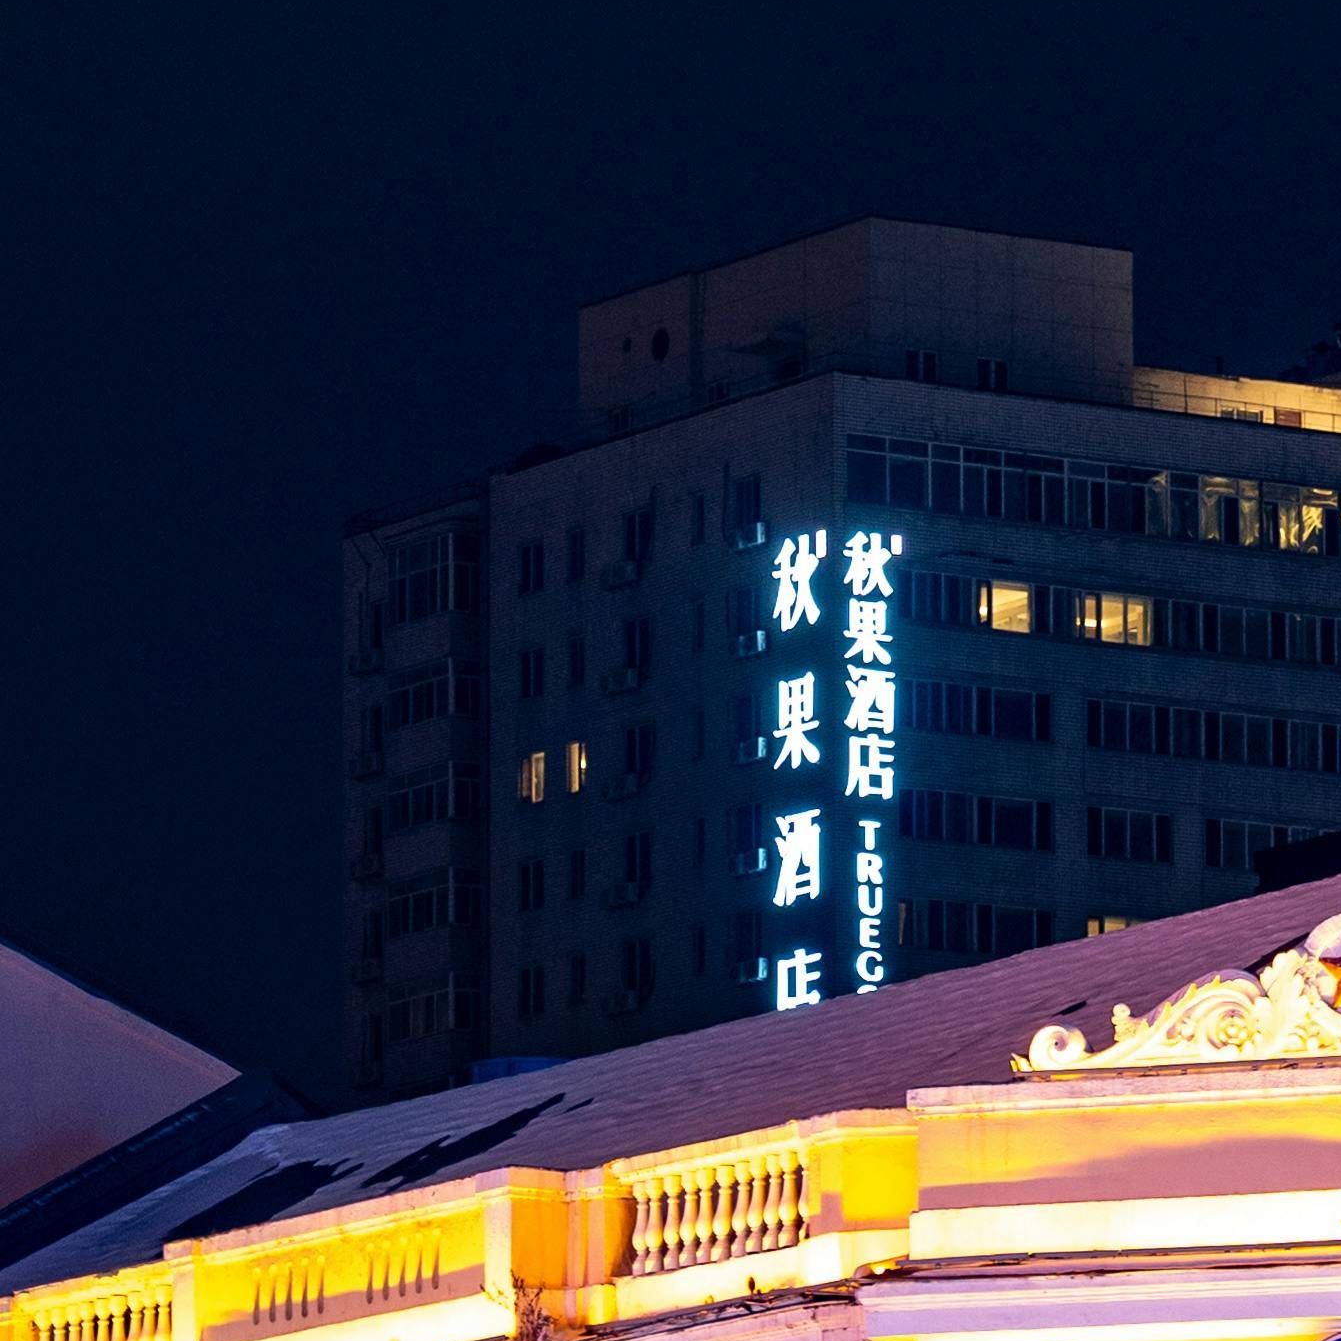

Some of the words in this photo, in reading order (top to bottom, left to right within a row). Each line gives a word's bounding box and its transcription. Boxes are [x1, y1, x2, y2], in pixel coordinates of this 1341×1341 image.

[772, 529, 827, 1012] 秋果酒店
[842, 529, 902, 800] 秋果酒店
[856, 820, 884, 995] TRUEG
